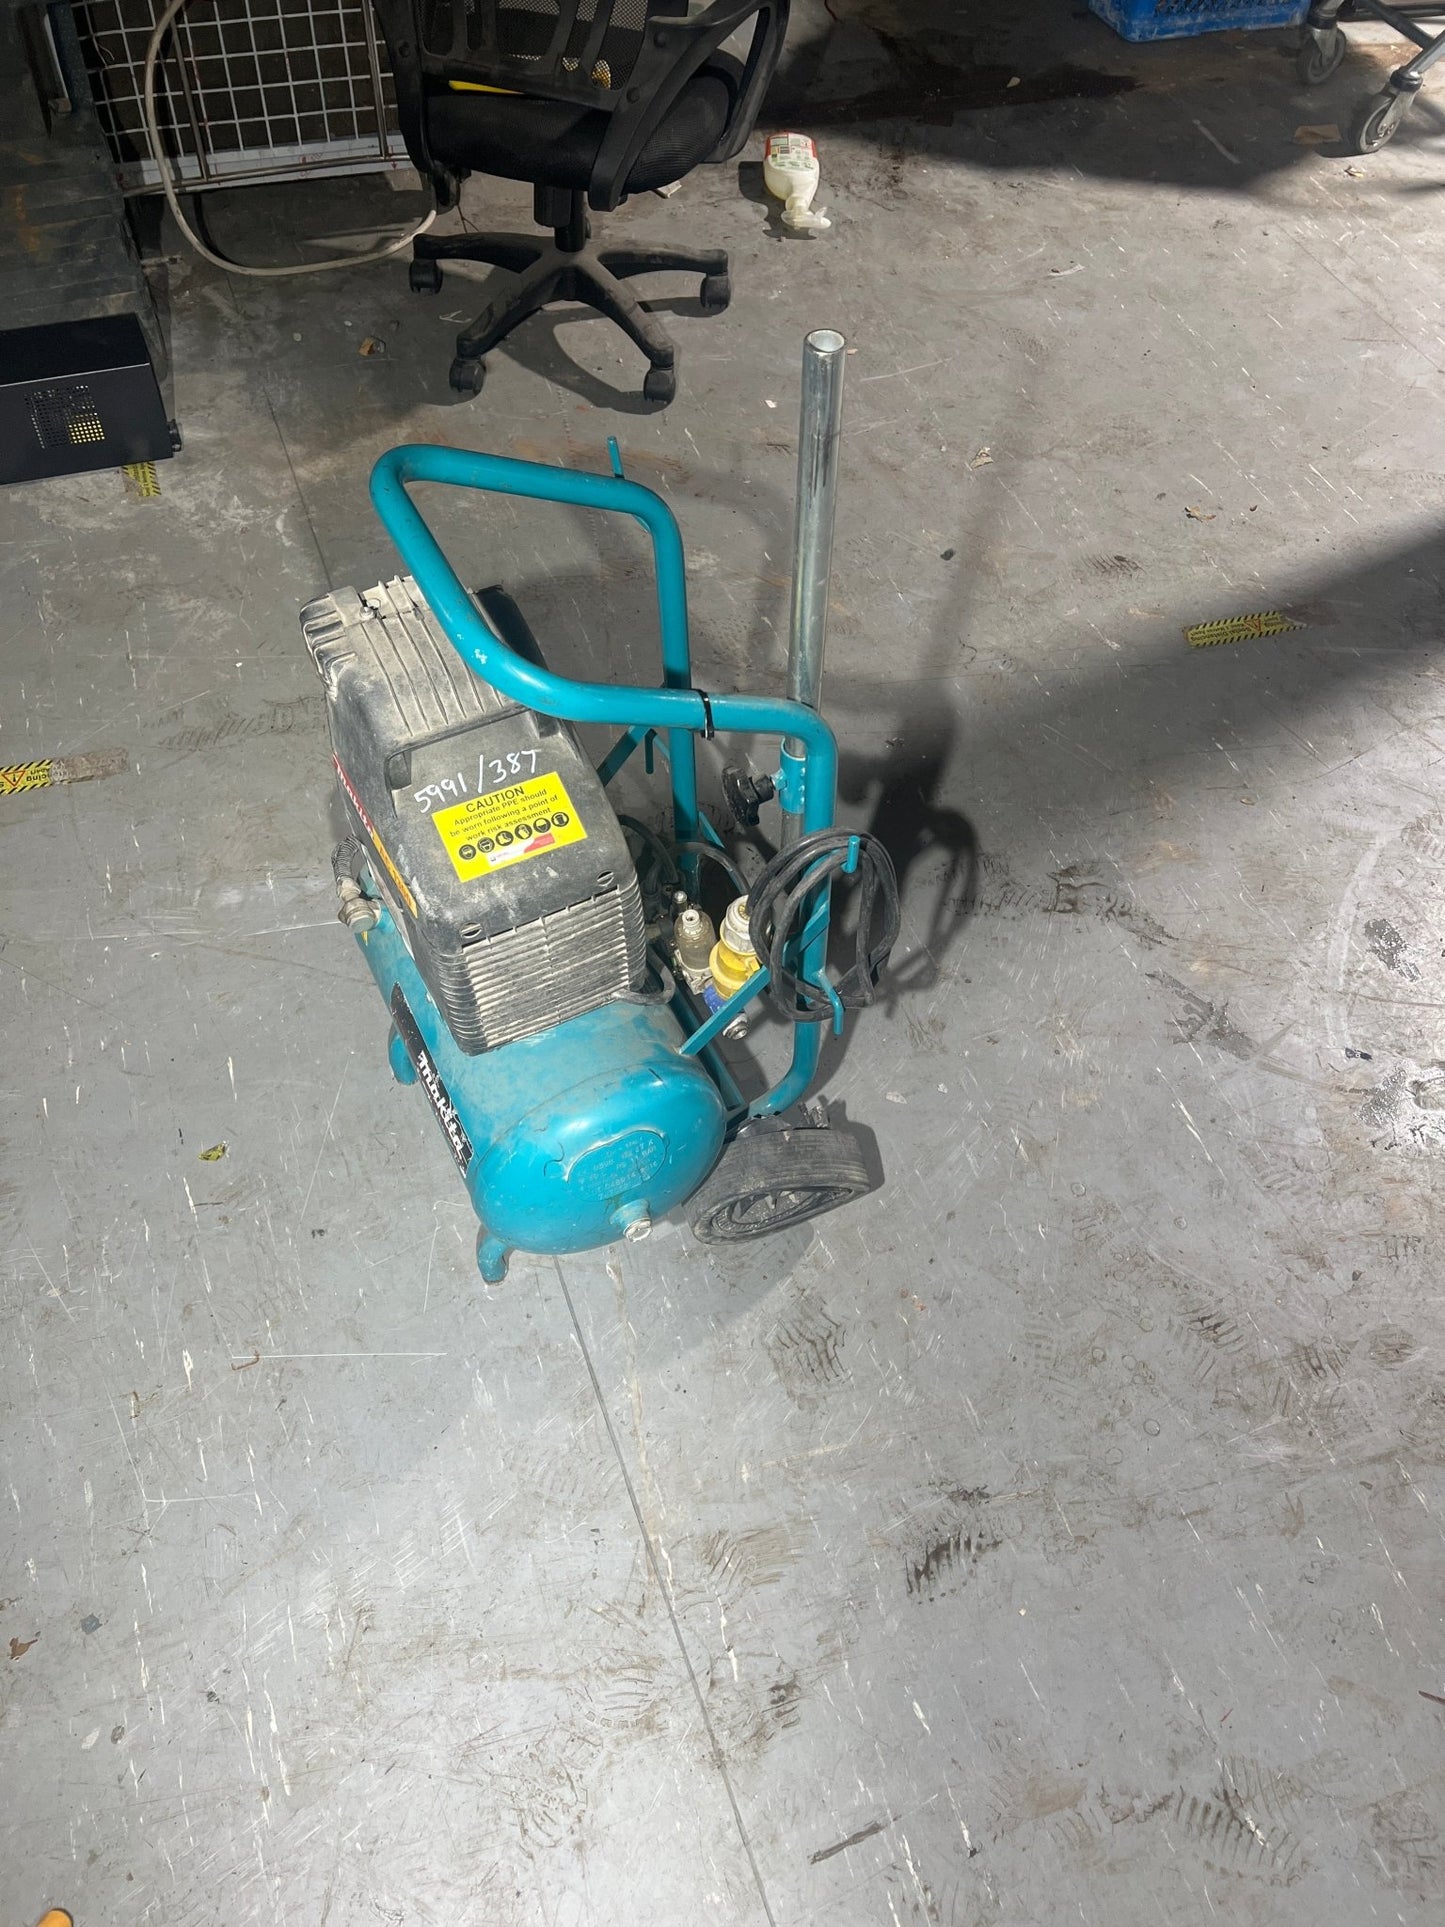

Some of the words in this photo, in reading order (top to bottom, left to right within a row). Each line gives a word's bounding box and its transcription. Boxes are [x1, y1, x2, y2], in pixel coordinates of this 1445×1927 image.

[454, 806, 501, 826] Appropriate
[501, 798, 519, 809] PPE
[520, 789, 547, 802] should
[462, 821, 483, 833] worn
[483, 808, 521, 825] following
[528, 798, 549, 811] point
[550, 794, 558, 802] of
[466, 786, 525, 813] CAUTION
[466, 830, 486, 841] work
[487, 824, 502, 834] risk
[504, 807, 551, 828] assessment
